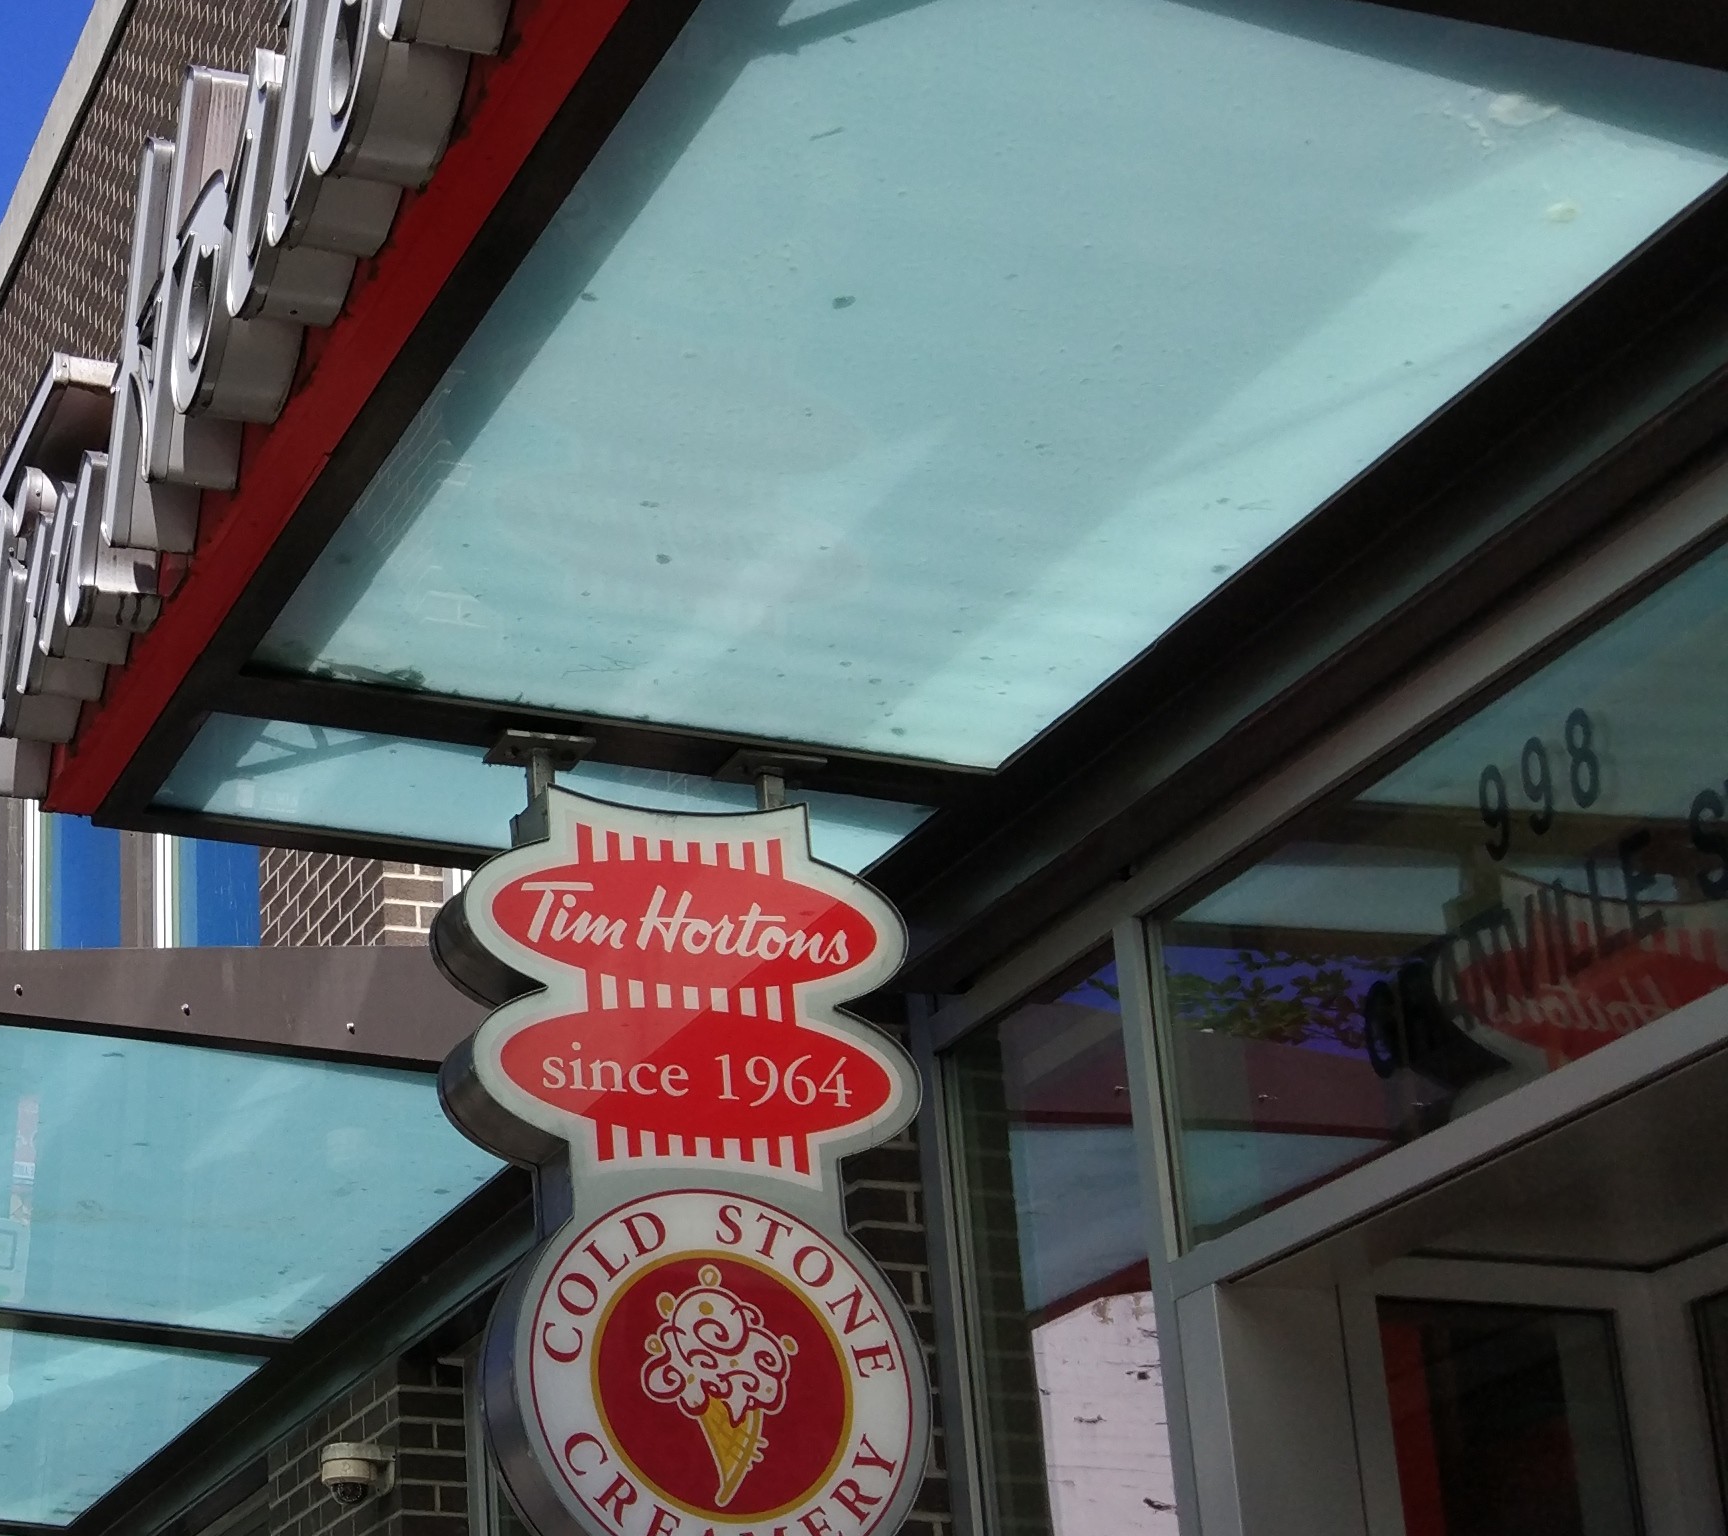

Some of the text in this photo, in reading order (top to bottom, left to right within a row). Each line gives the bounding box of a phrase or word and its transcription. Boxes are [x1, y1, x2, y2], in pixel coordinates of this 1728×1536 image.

[1478, 707, 1601, 862] 998
[519, 880, 851, 968] Tim Hortons
[541, 1041, 854, 1111] since 1964
[541, 1201, 898, 1381] COLD STONE
